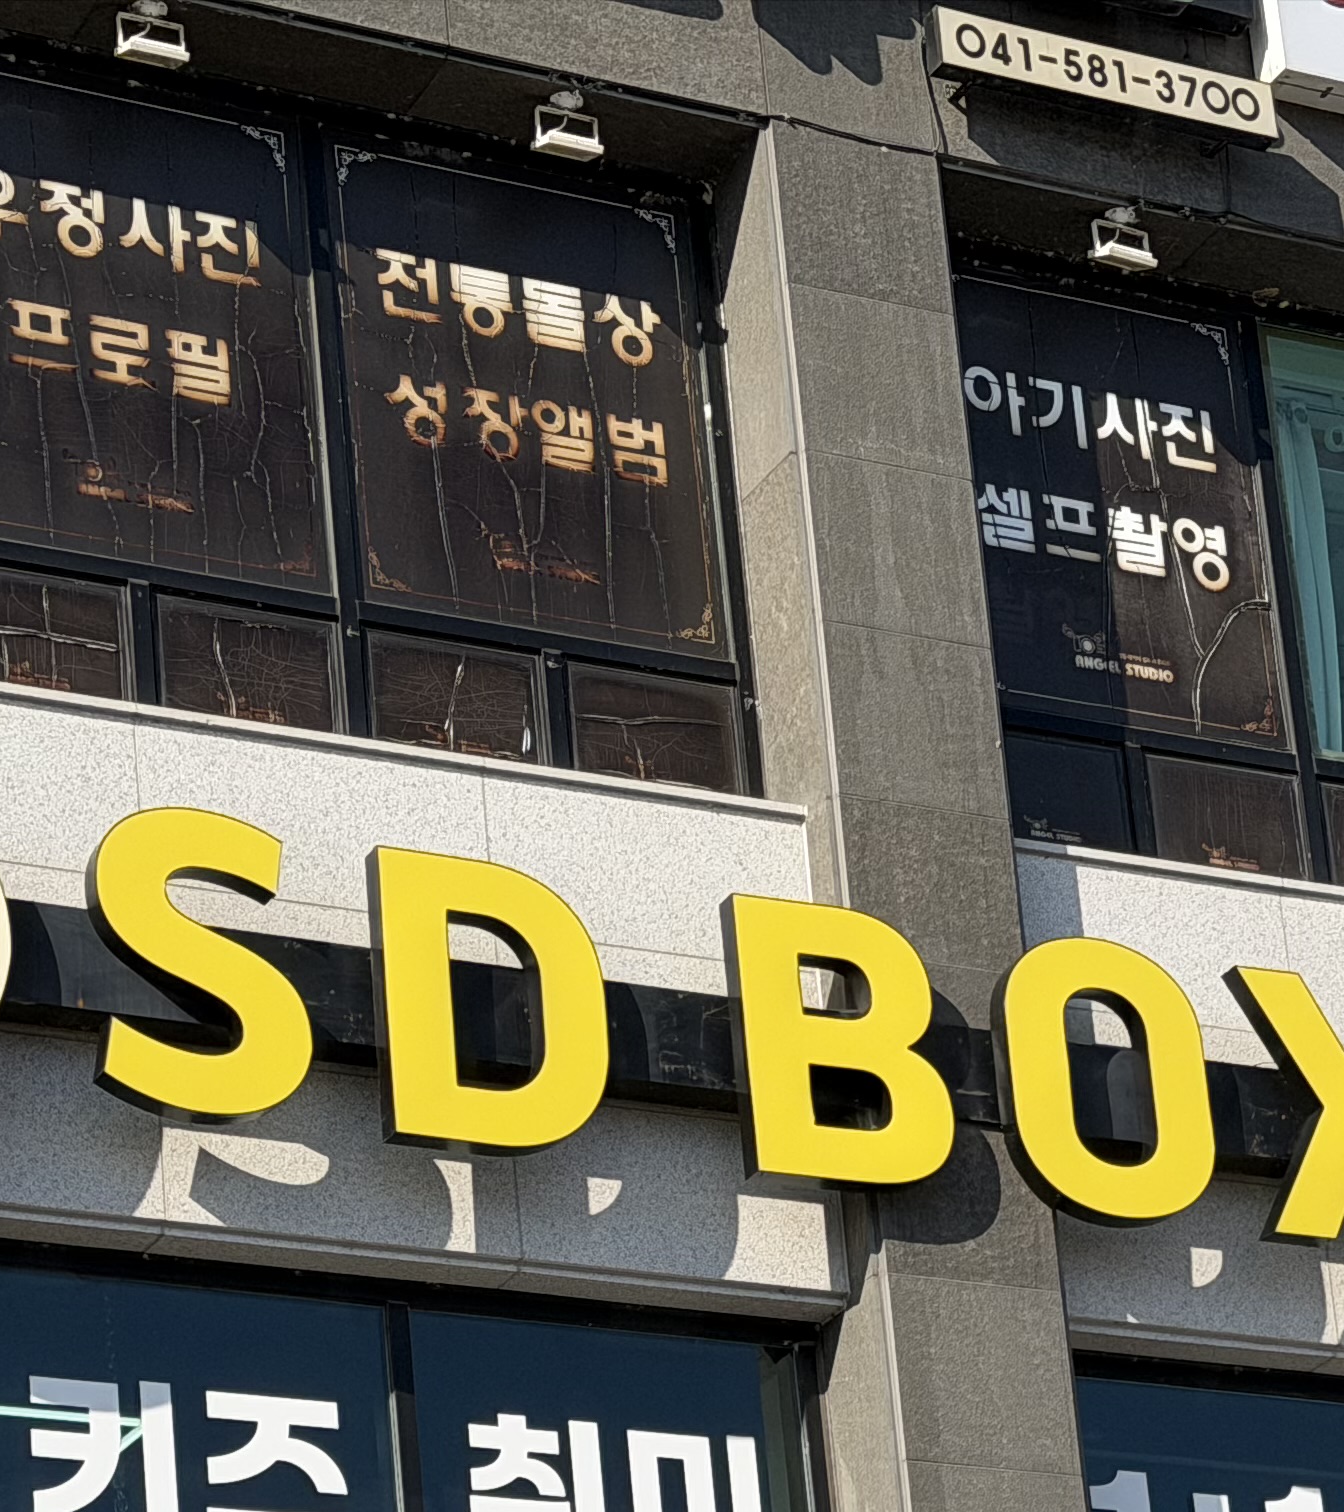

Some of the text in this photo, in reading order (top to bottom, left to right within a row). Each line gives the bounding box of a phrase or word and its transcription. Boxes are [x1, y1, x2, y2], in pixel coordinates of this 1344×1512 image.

[955, 23, 1261, 121] 041-581-3700
[7, 297, 232, 407] 프로필
[375, 248, 661, 367] 전통돌상
[384, 374, 668, 487] 성장앨범
[963, 365, 1217, 474] 아기사진
[977, 483, 1230, 592] 셀프촬영
[1125, 662, 1175, 684] STUDIO
[86, 806, 612, 1148] SD
